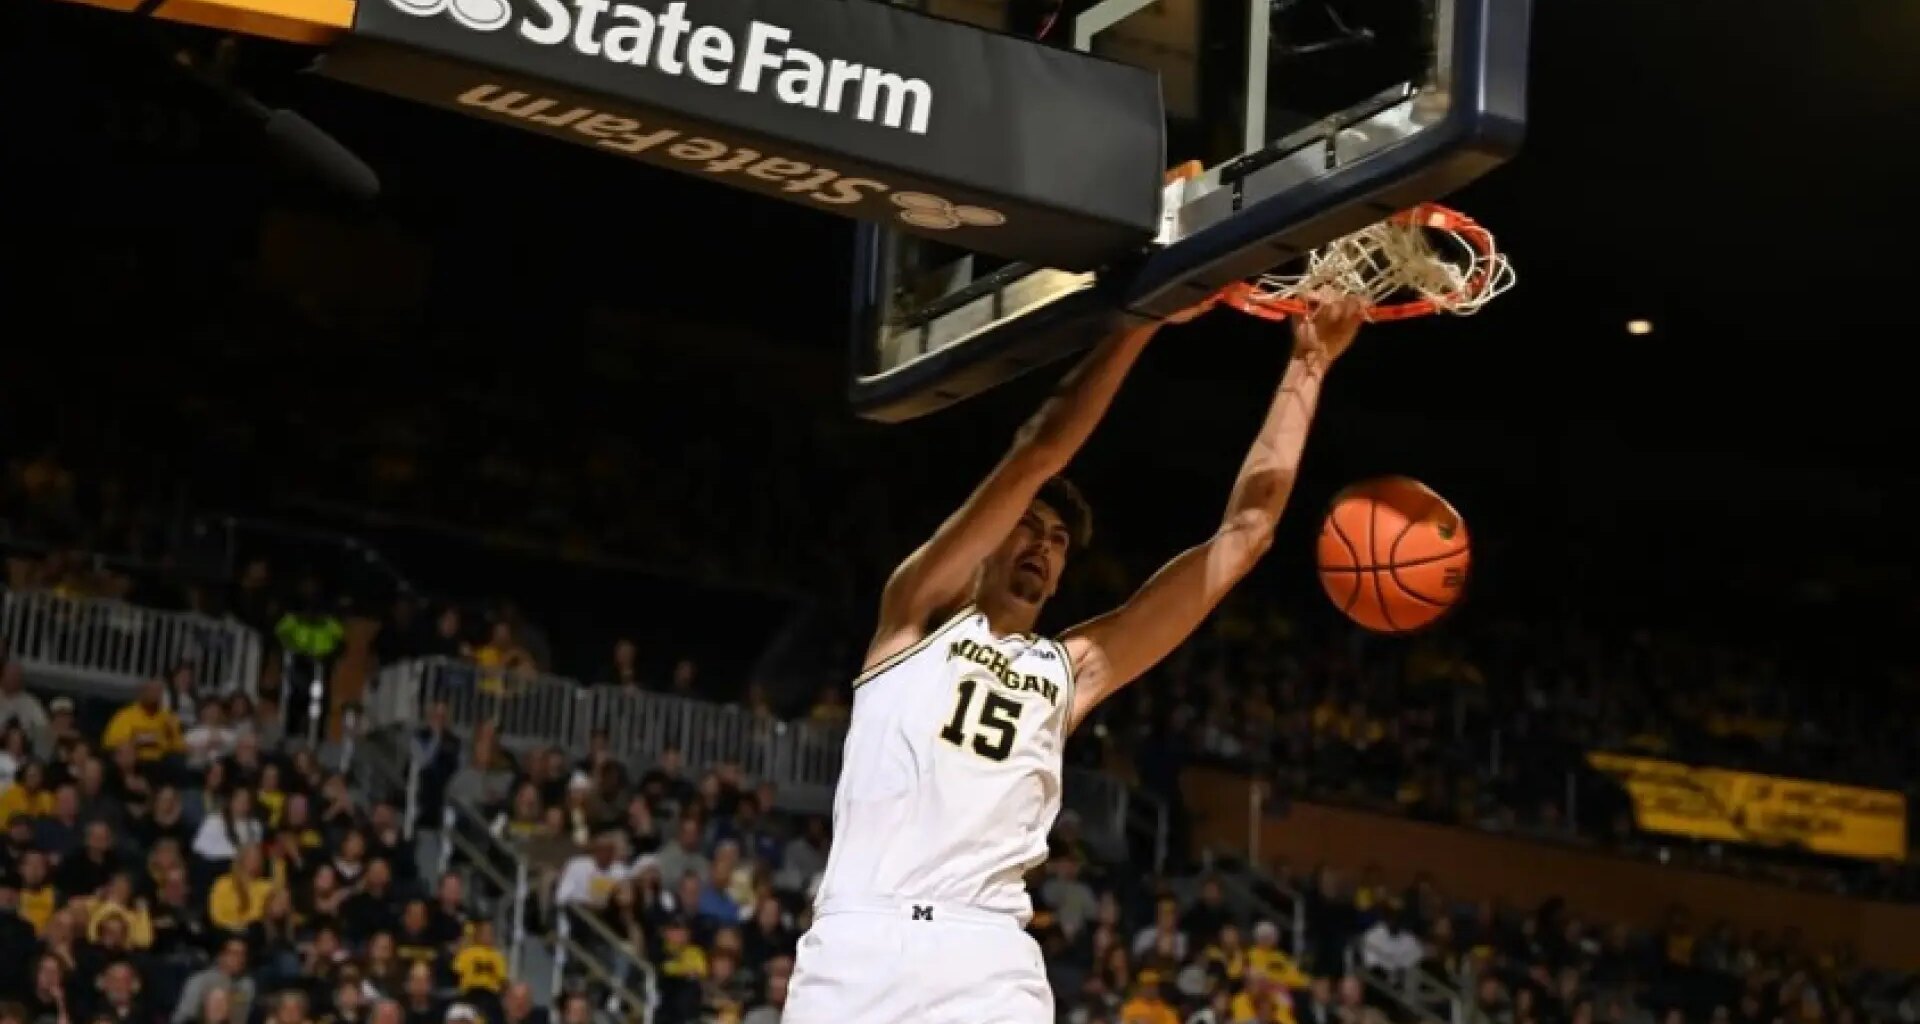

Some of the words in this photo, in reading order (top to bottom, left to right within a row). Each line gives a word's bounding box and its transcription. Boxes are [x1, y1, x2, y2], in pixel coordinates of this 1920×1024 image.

[948, 638, 1060, 706] MICHGAN
[940, 680, 1023, 761] 15
[912, 905, 934, 921] M
